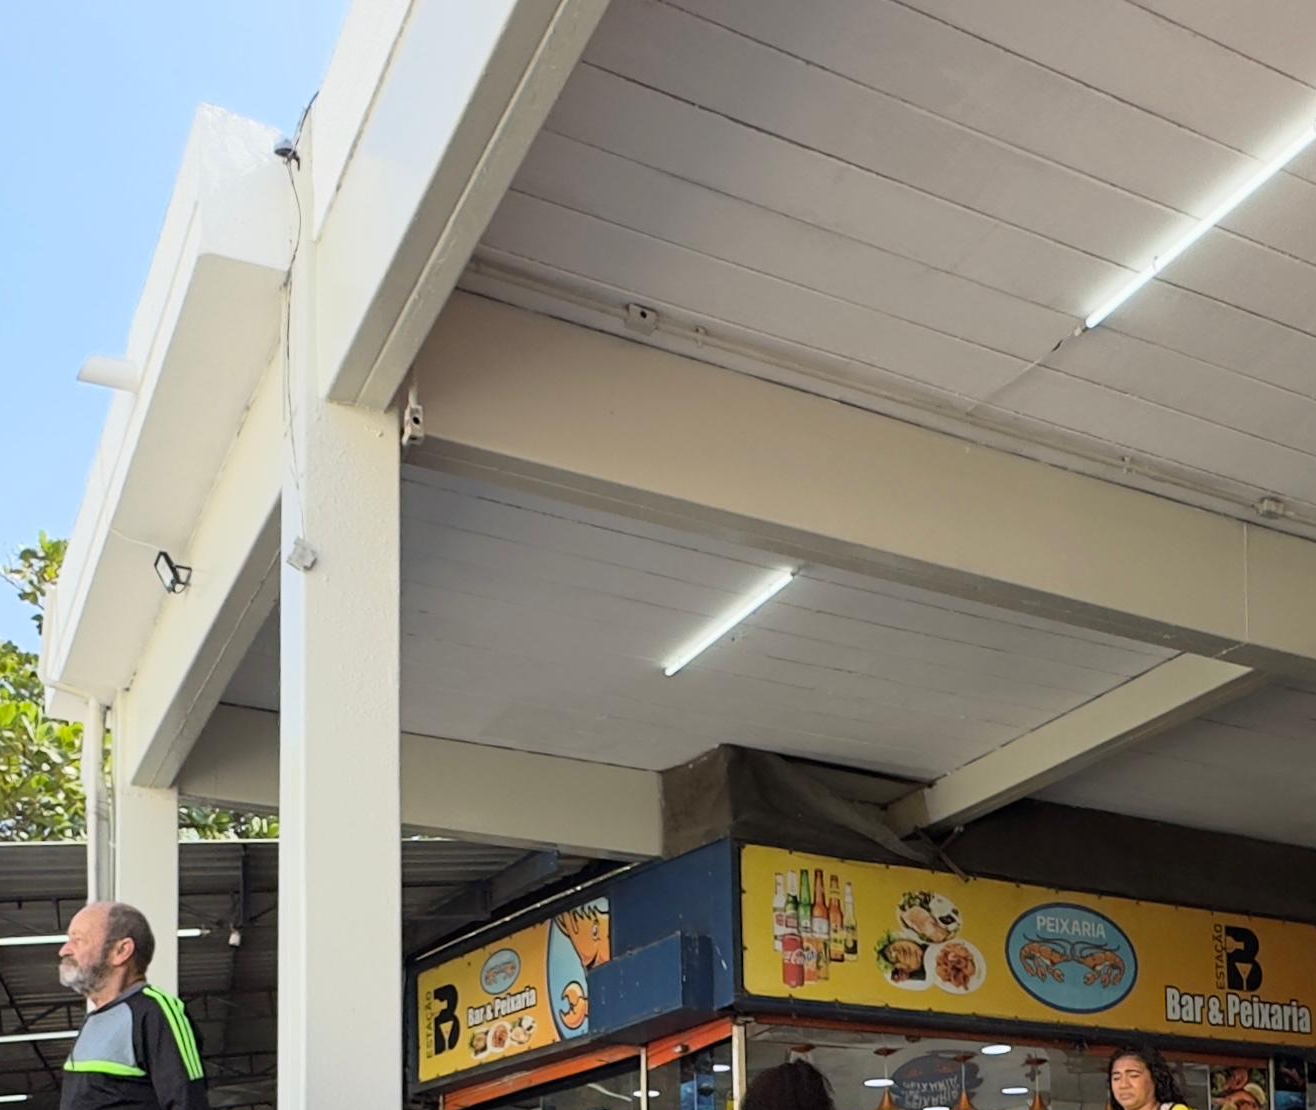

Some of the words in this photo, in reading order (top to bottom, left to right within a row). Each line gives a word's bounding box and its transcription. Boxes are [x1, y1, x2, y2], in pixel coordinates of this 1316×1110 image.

[1036, 915, 1106, 939] PEIXARIA
[1212, 923, 1225, 990] ESTAÇÃO
[467, 1004, 486, 1029] Bar
[485, 1003, 494, 1022] &
[494, 985, 538, 1019] Peixaria
[1165, 985, 1205, 1025] Bar
[1207, 995, 1226, 1027] &
[1226, 992, 1313, 1036] Peixaria
